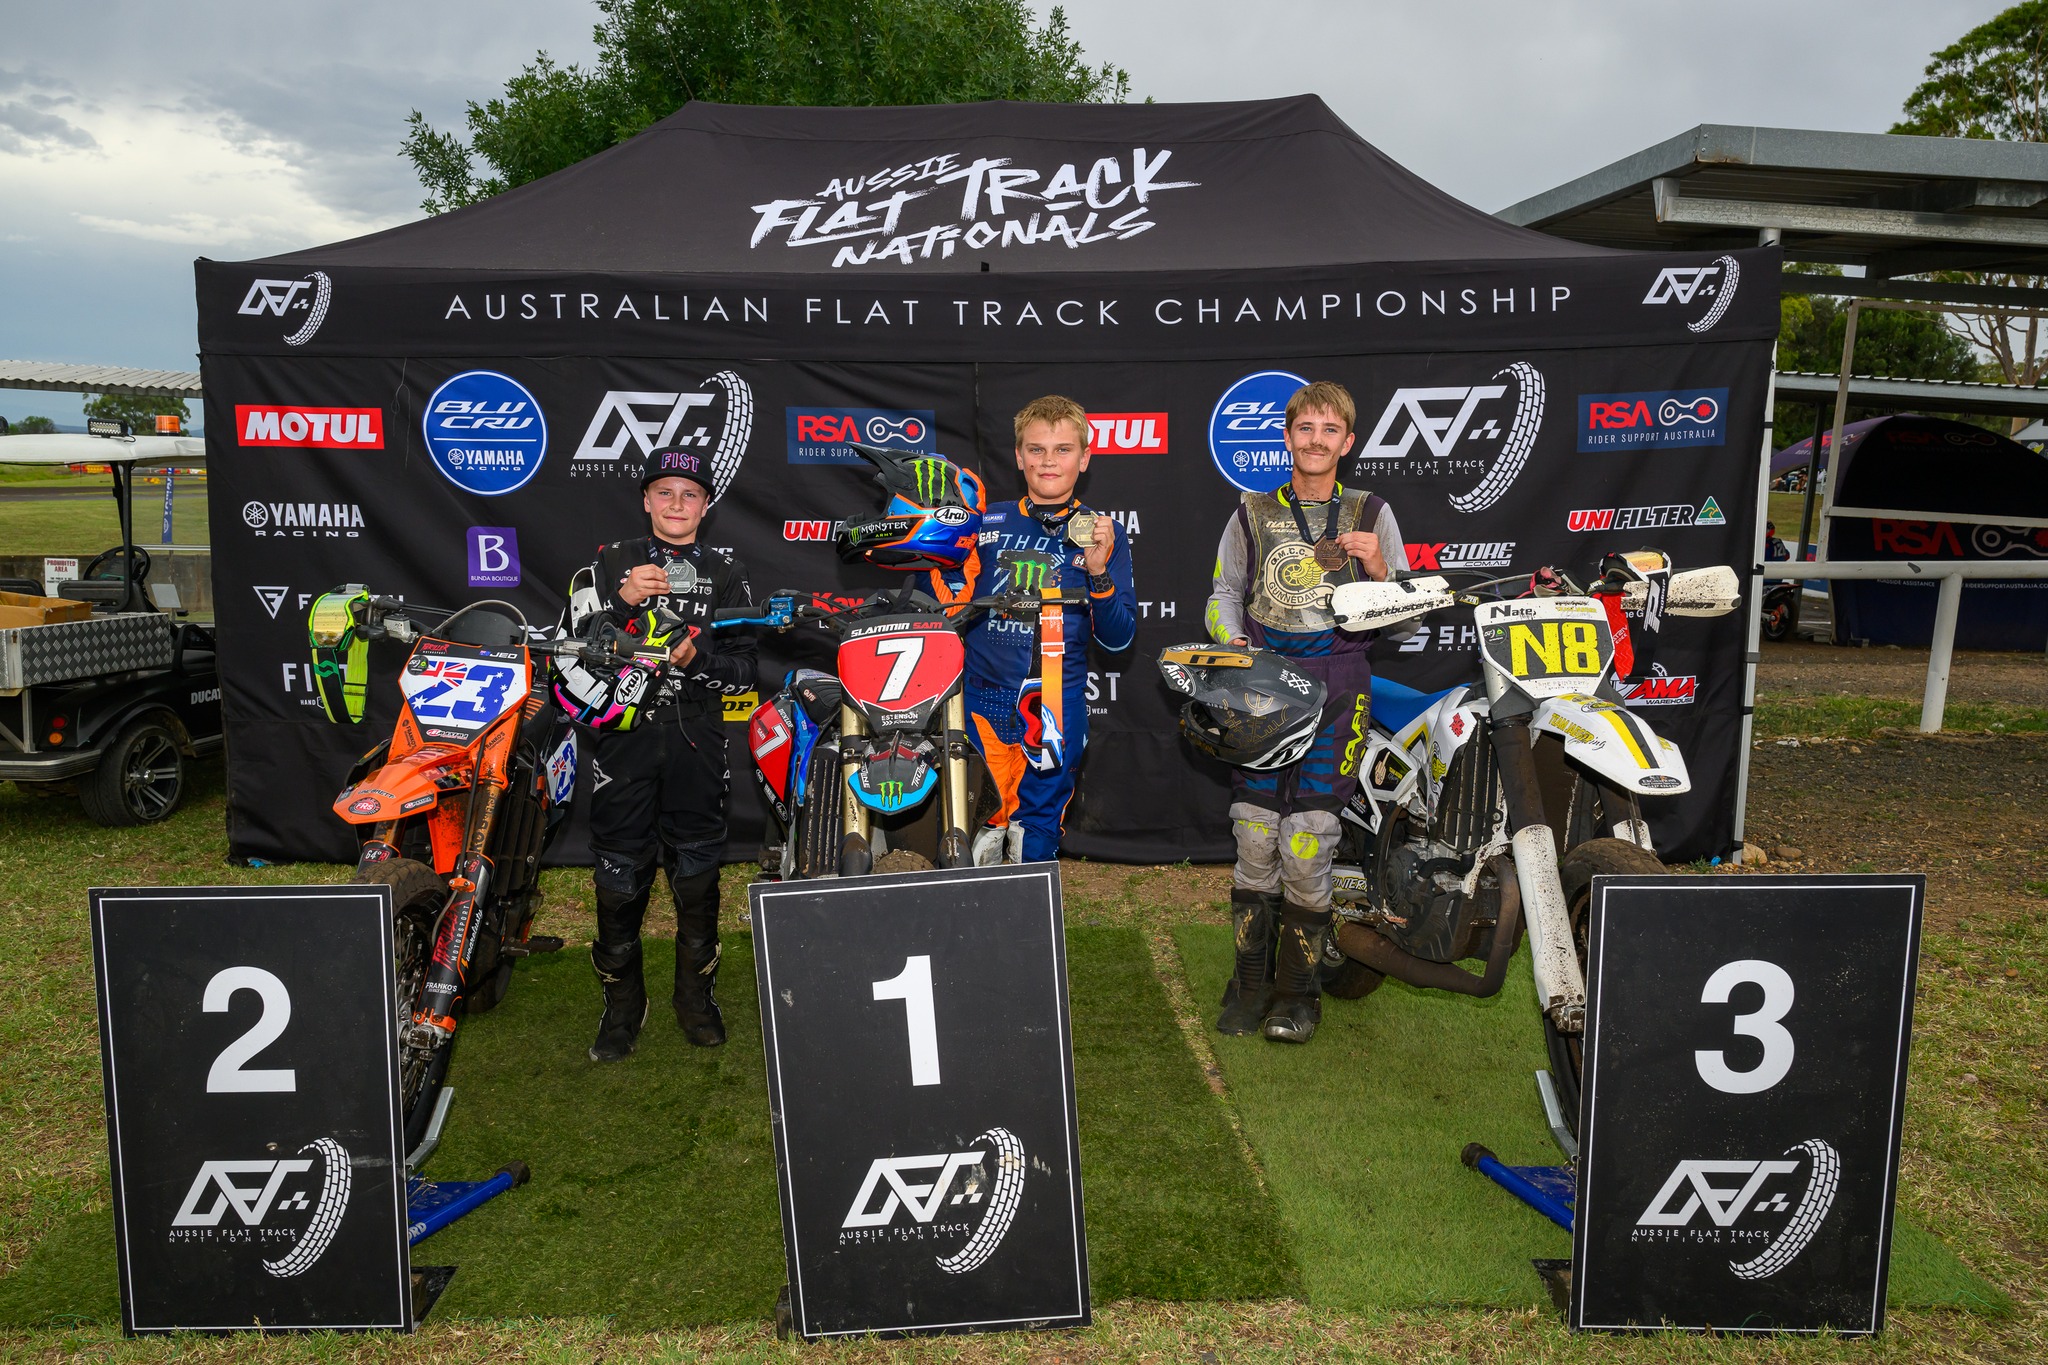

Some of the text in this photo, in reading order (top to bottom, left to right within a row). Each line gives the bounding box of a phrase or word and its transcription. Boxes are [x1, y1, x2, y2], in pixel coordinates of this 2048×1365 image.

[816, 153, 959, 201] AUSSIE
[751, 147, 1201, 248] FLAT TRACK
[832, 207, 1156, 267] NATIONALS
[445, 286, 1571, 325] AUSTRALIAN FLAT TRACK CHAMPIONSHIP
[434, 400, 527, 414] BLU
[1221, 402, 1286, 416] BL
[1589, 400, 1653, 429] RSA
[245, 411, 377, 443] MOTUL
[440, 416, 534, 430] CRU
[798, 416, 861, 442] RSA
[1089, 418, 1162, 449] TUL
[1227, 418, 1286, 431] CR
[1588, 429, 1715, 444] RIDER SUPPORT AUSTRALIA
[465, 450, 525, 465] YAMAHA
[661, 452, 700, 473] FIST
[798, 448, 859, 457] RIDER SUPP
[1250, 449, 1294, 465] YAMA
[1356, 459, 1485, 471] AUSSIE FLAT TRACK
[269, 502, 365, 528] YAMAHA
[979, 531, 999, 542] GAS
[1000, 534, 1056, 551] THO
[1268, 581, 1318, 604] GUNNEDAH
[640, 595, 708, 616] ORTH
[1364, 600, 1434, 620] Barkbusters
[912, 621, 943, 629] SAM
[1509, 621, 1601, 677] N8
[875, 636, 925, 703] 7
[1163, 663, 1190, 693] Airoh
[407, 660, 515, 723] 23
[881, 712, 919, 721] ESTENSON
[754, 722, 790, 761] 7
[451, 905, 470, 962] MOTORSPORT
[203, 967, 296, 1093] 2
[873, 955, 940, 1087] 1
[1695, 960, 1795, 1094] 3
[169, 1229, 296, 1238] AUSSIE FLAT TRACK
[839, 1223, 970, 1239] AUSSIE FLAT TRACK
[839, 1230, 971, 1245] NATIONALS
[1632, 1229, 1770, 1238] AUSSIE FLAT TRACK
